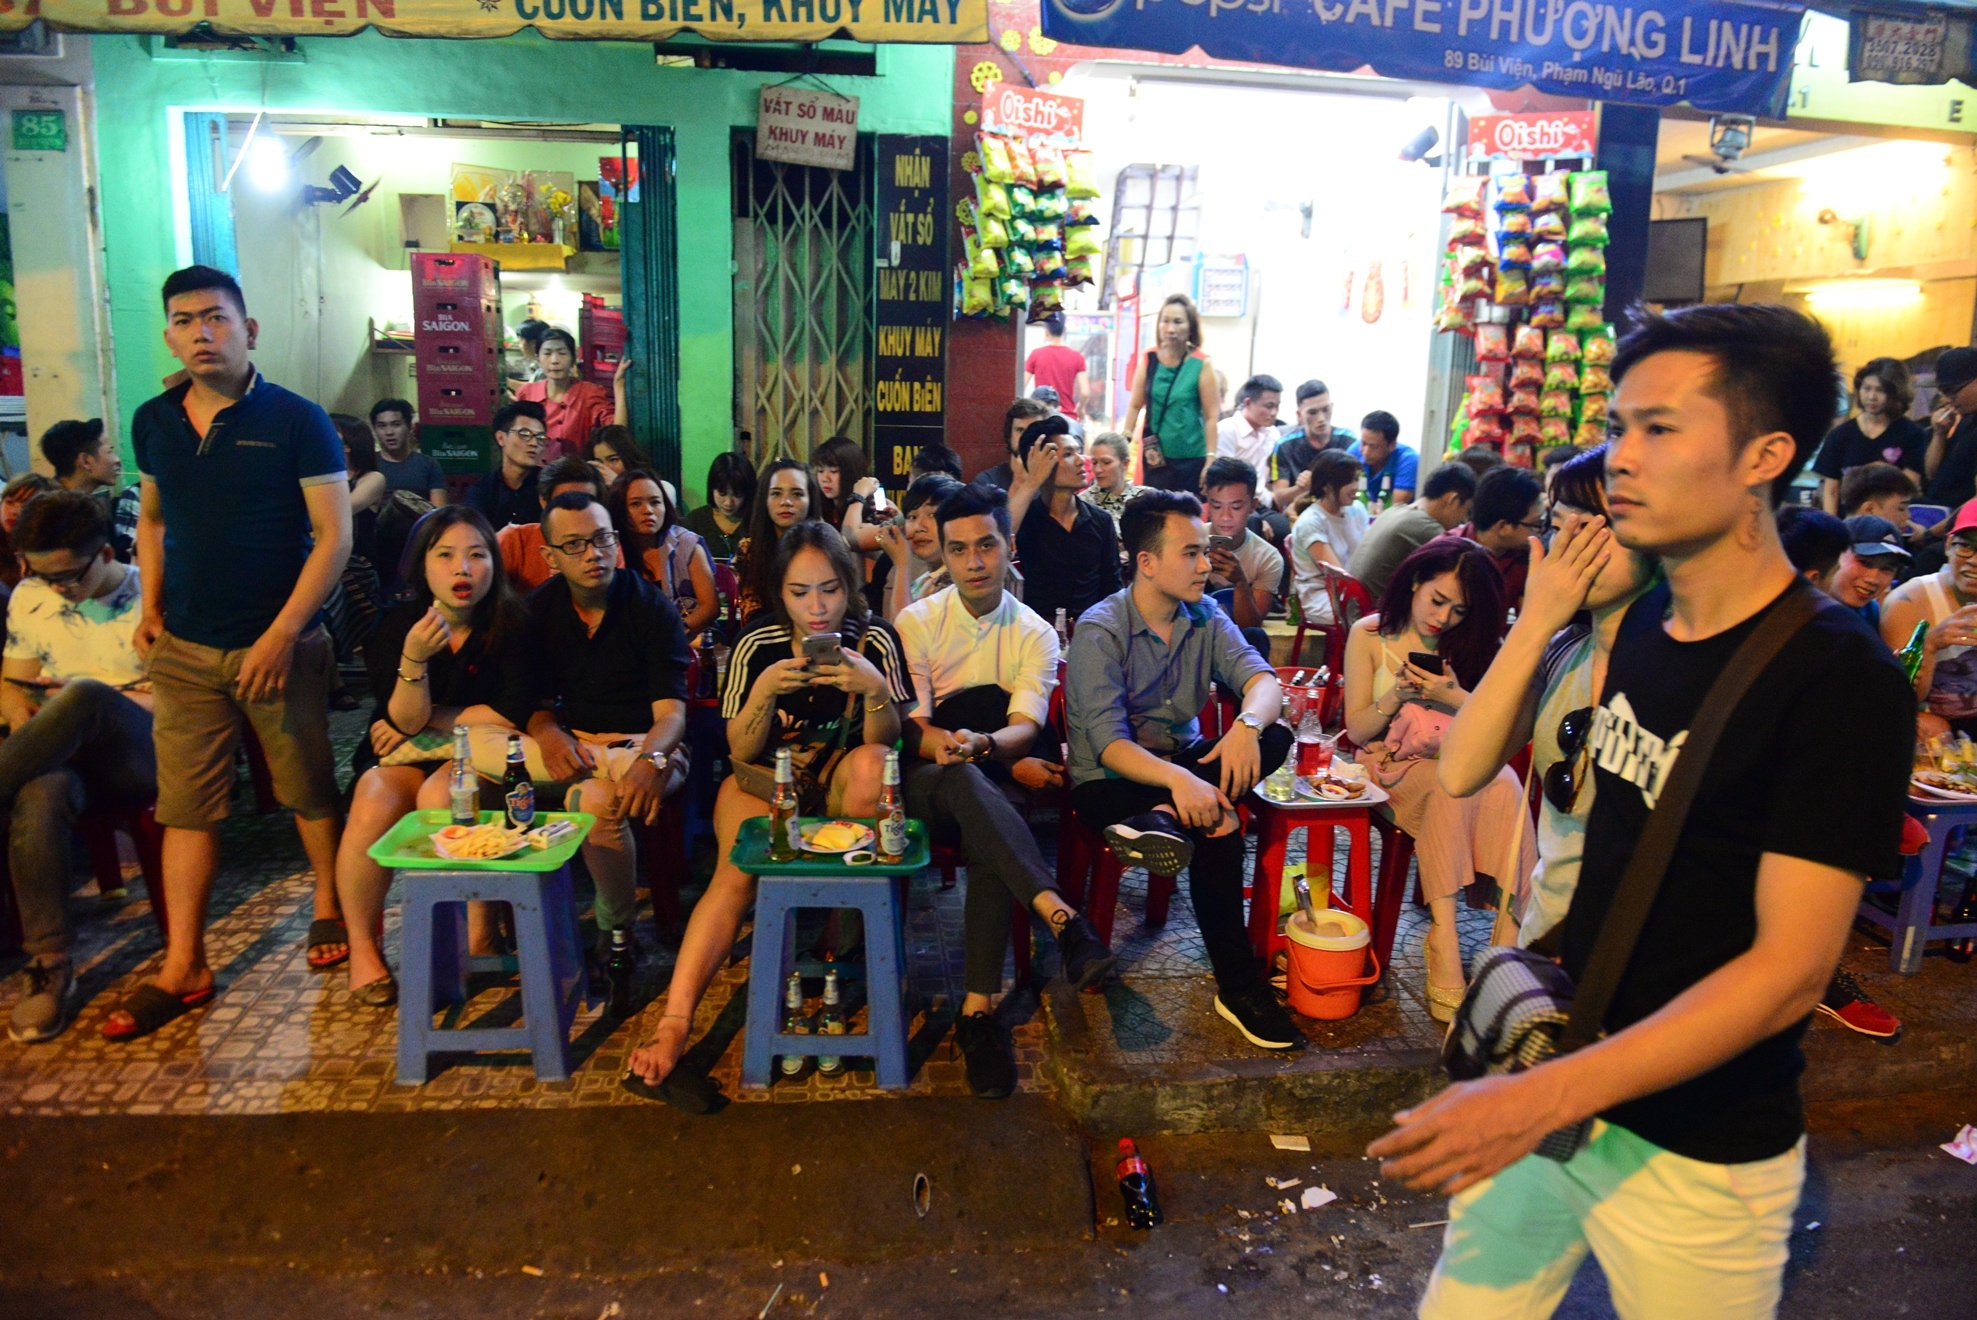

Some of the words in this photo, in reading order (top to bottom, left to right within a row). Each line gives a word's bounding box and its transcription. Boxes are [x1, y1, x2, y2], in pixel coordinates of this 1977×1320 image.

[1679, 15, 1778, 72] LINH
[1444, 49, 1464, 69] 89
[1541, 60, 1588, 86] Phạm
[21, 114, 59, 136] 85
[1000, 89, 1058, 129] Oishi
[768, 124, 808, 145] KHUY
[813, 129, 847, 150] MÁY
[1494, 119, 1564, 150] Oishi
[895, 147, 931, 197] NHẬN
[879, 268, 907, 301] MAY
[909, 270, 917, 302] 2
[919, 270, 942, 303] KIM
[422, 320, 471, 332] SAIGON
[878, 325, 912, 358] KHUY
[914, 317, 942, 358] MÁY
